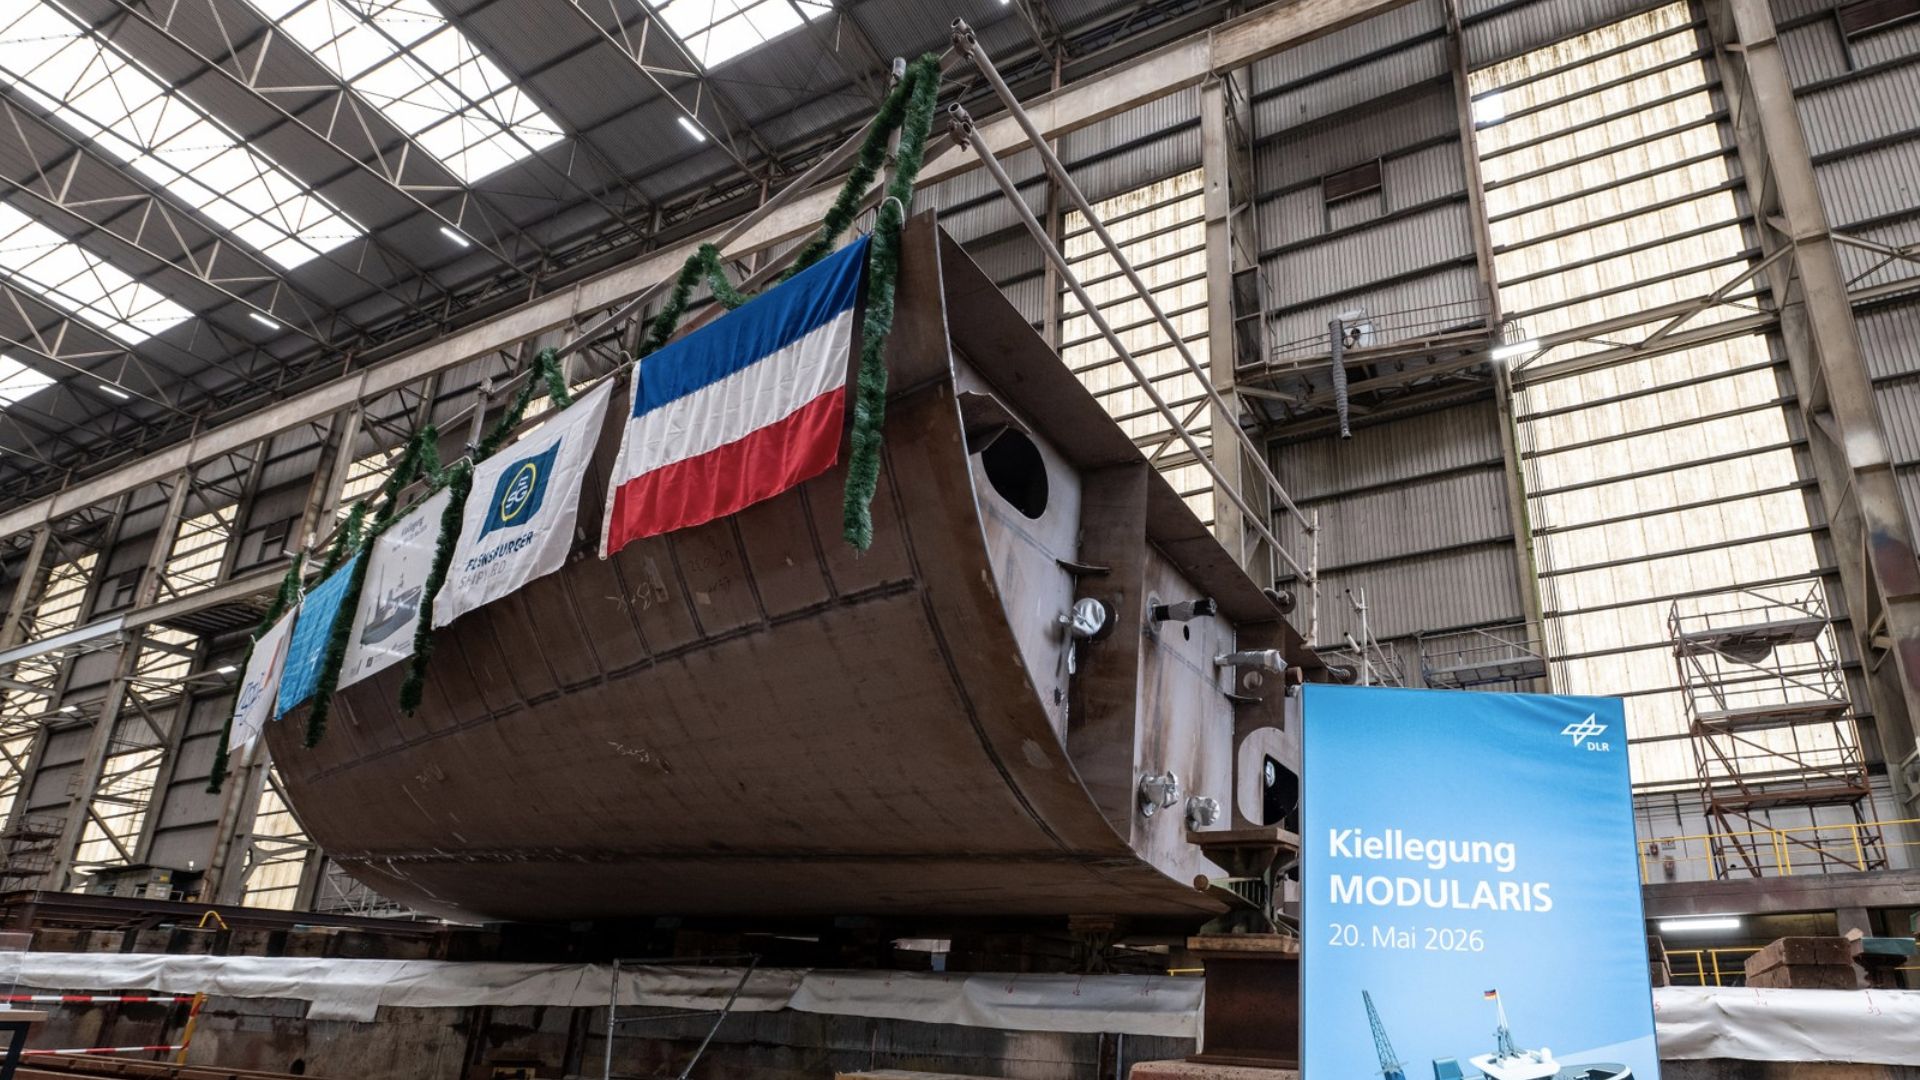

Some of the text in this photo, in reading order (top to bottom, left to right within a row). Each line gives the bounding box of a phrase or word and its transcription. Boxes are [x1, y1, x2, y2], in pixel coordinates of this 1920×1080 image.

[1587, 741, 1610, 752] DLR
[1329, 828, 1516, 872] Kiellegung
[1330, 874, 1553, 912] MODULARIS
[1328, 923, 1485, 952] 20. Mai 2026
